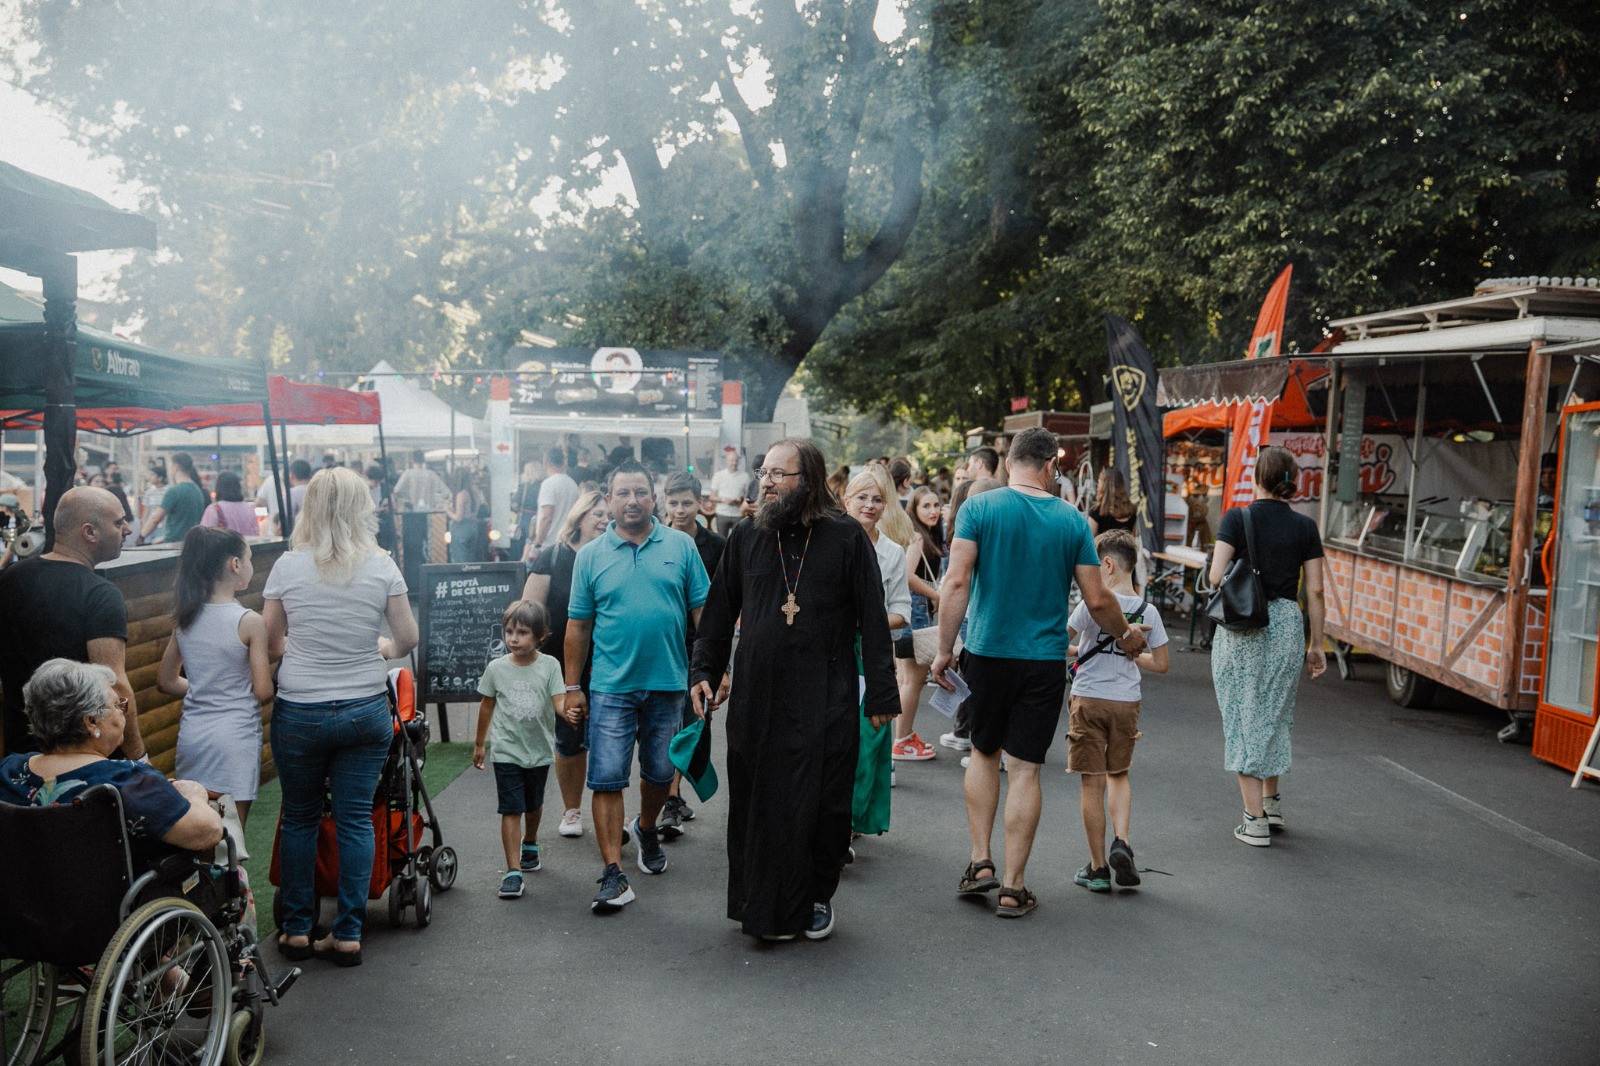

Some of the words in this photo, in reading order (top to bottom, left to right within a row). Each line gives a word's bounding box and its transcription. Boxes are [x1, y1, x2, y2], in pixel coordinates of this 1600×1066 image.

[516, 388, 534, 403] 22
[451, 577, 479, 588] POFTĂ
[451, 588, 463, 597] DE
[464, 587, 476, 596] CE
[477, 585, 496, 594] VREI
[497, 584, 510, 593] TU
